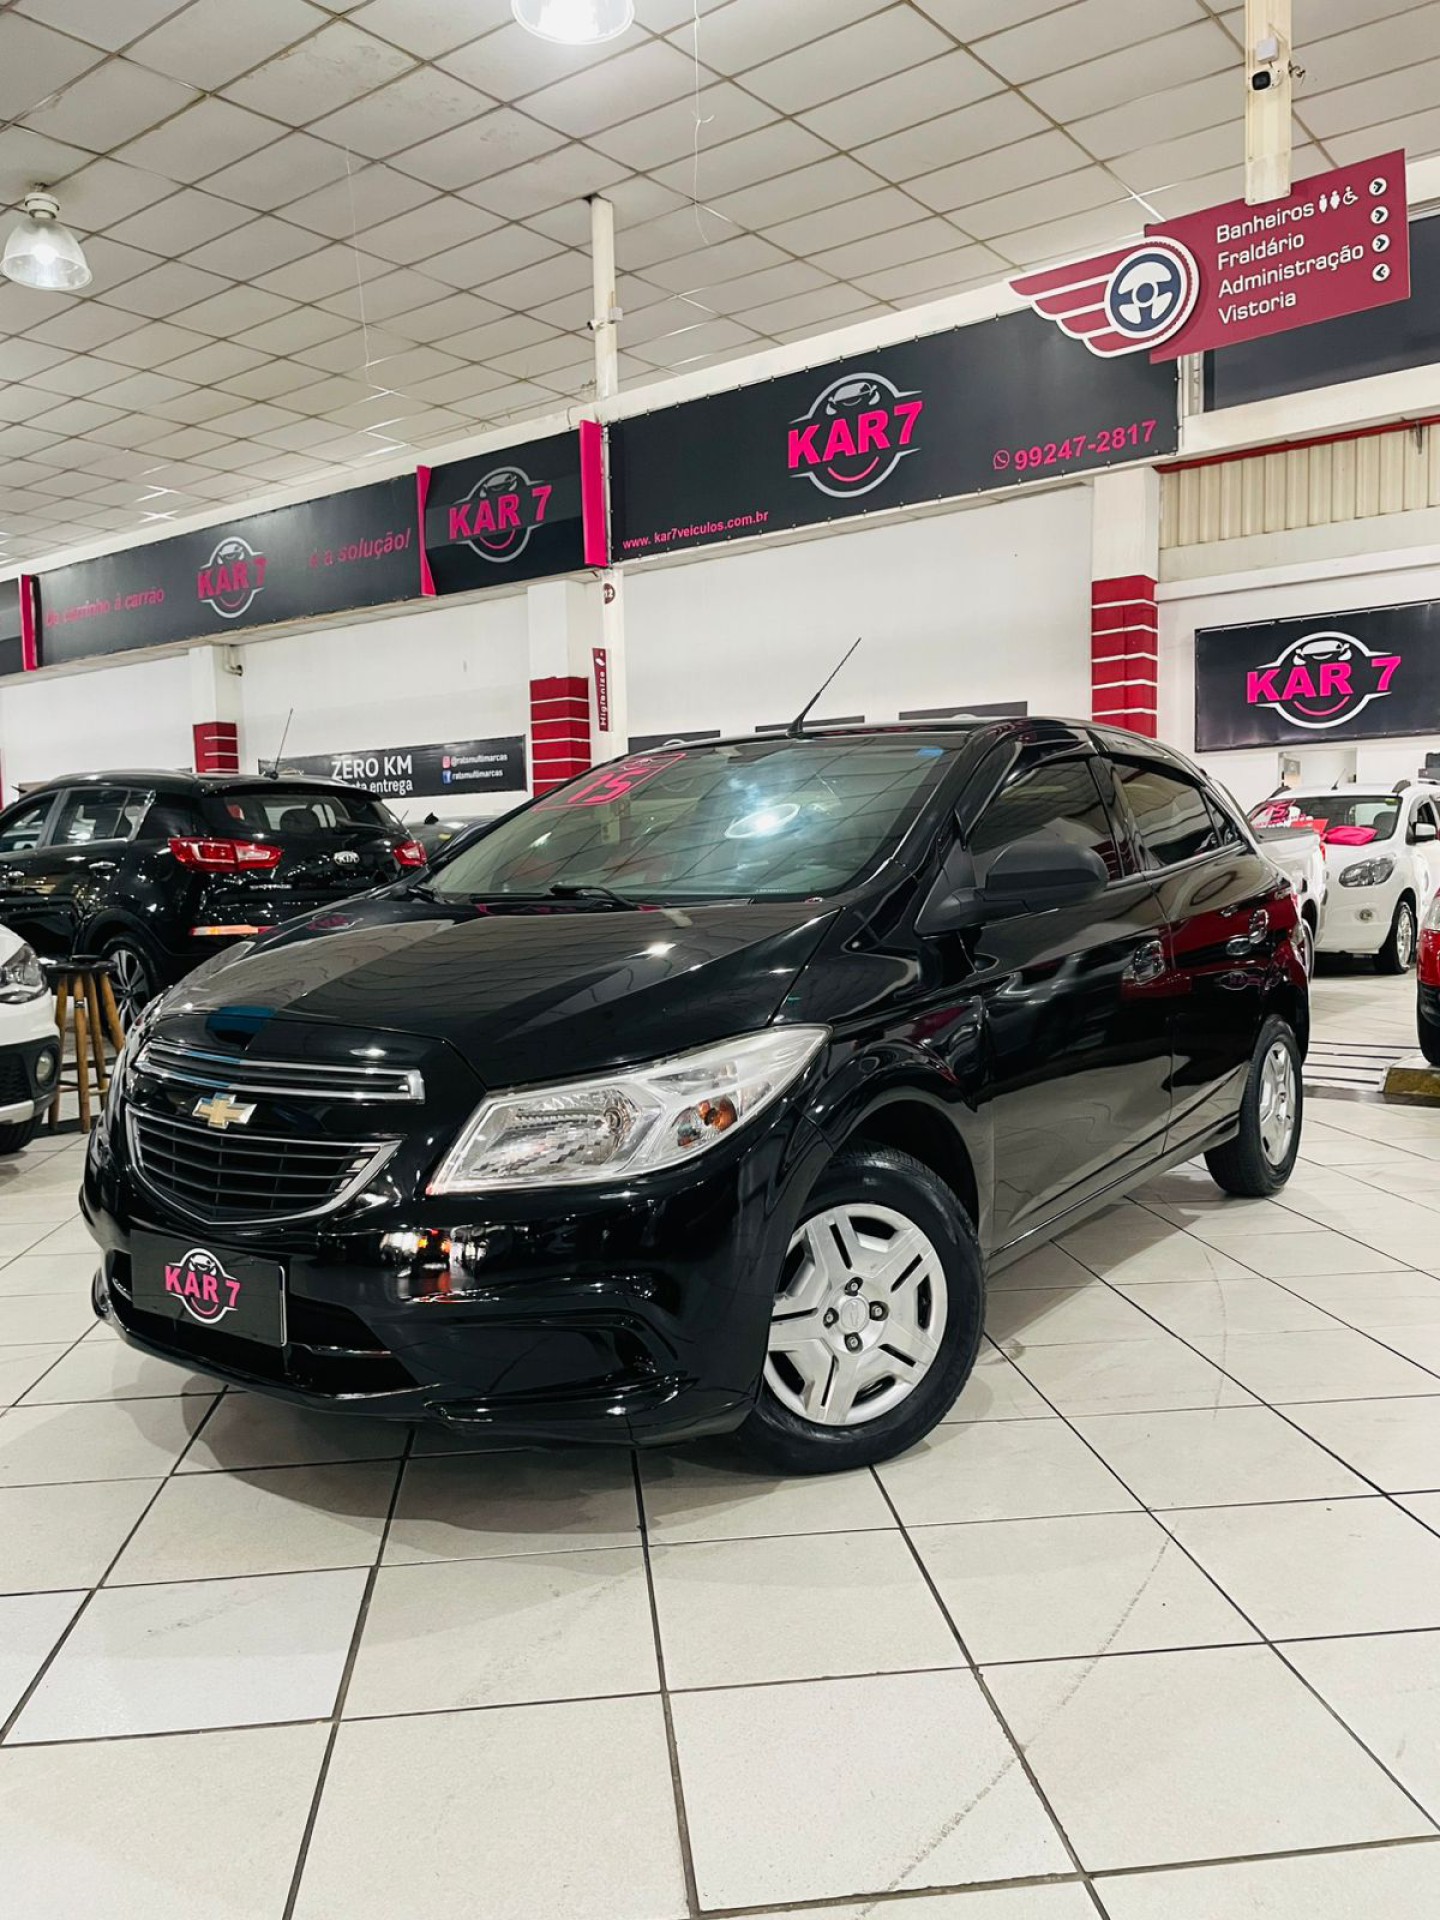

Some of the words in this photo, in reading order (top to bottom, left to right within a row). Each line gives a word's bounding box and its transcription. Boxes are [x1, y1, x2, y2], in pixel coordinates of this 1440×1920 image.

[1216, 202, 1315, 244] Banheiros
[1218, 232, 1305, 271] Fraldário
[1218, 244, 1364, 299] Administração
[1218, 291, 1297, 325] Vistoria
[787, 409, 891, 469] KAR
[893, 400, 924, 446] 7
[1014, 419, 1157, 471] 99247-2817
[449, 493, 522, 540] KAR
[532, 484, 552, 521] 7
[622, 536, 651, 550] www.
[654, 510, 769, 544] kar7veiculos.com.br
[323, 550, 333, 565] a
[337, 528, 412, 562] solução!
[197, 561, 250, 600] KAR
[253, 556, 267, 588] 7
[1247, 663, 1354, 704] KAR
[1371, 655, 1402, 691] 7
[331, 758, 380, 780] ZERO
[384, 755, 413, 776] KM
[370, 779, 414, 796] entrega
[165, 1265, 219, 1303] KAR
[225, 1280, 240, 1307] 7
